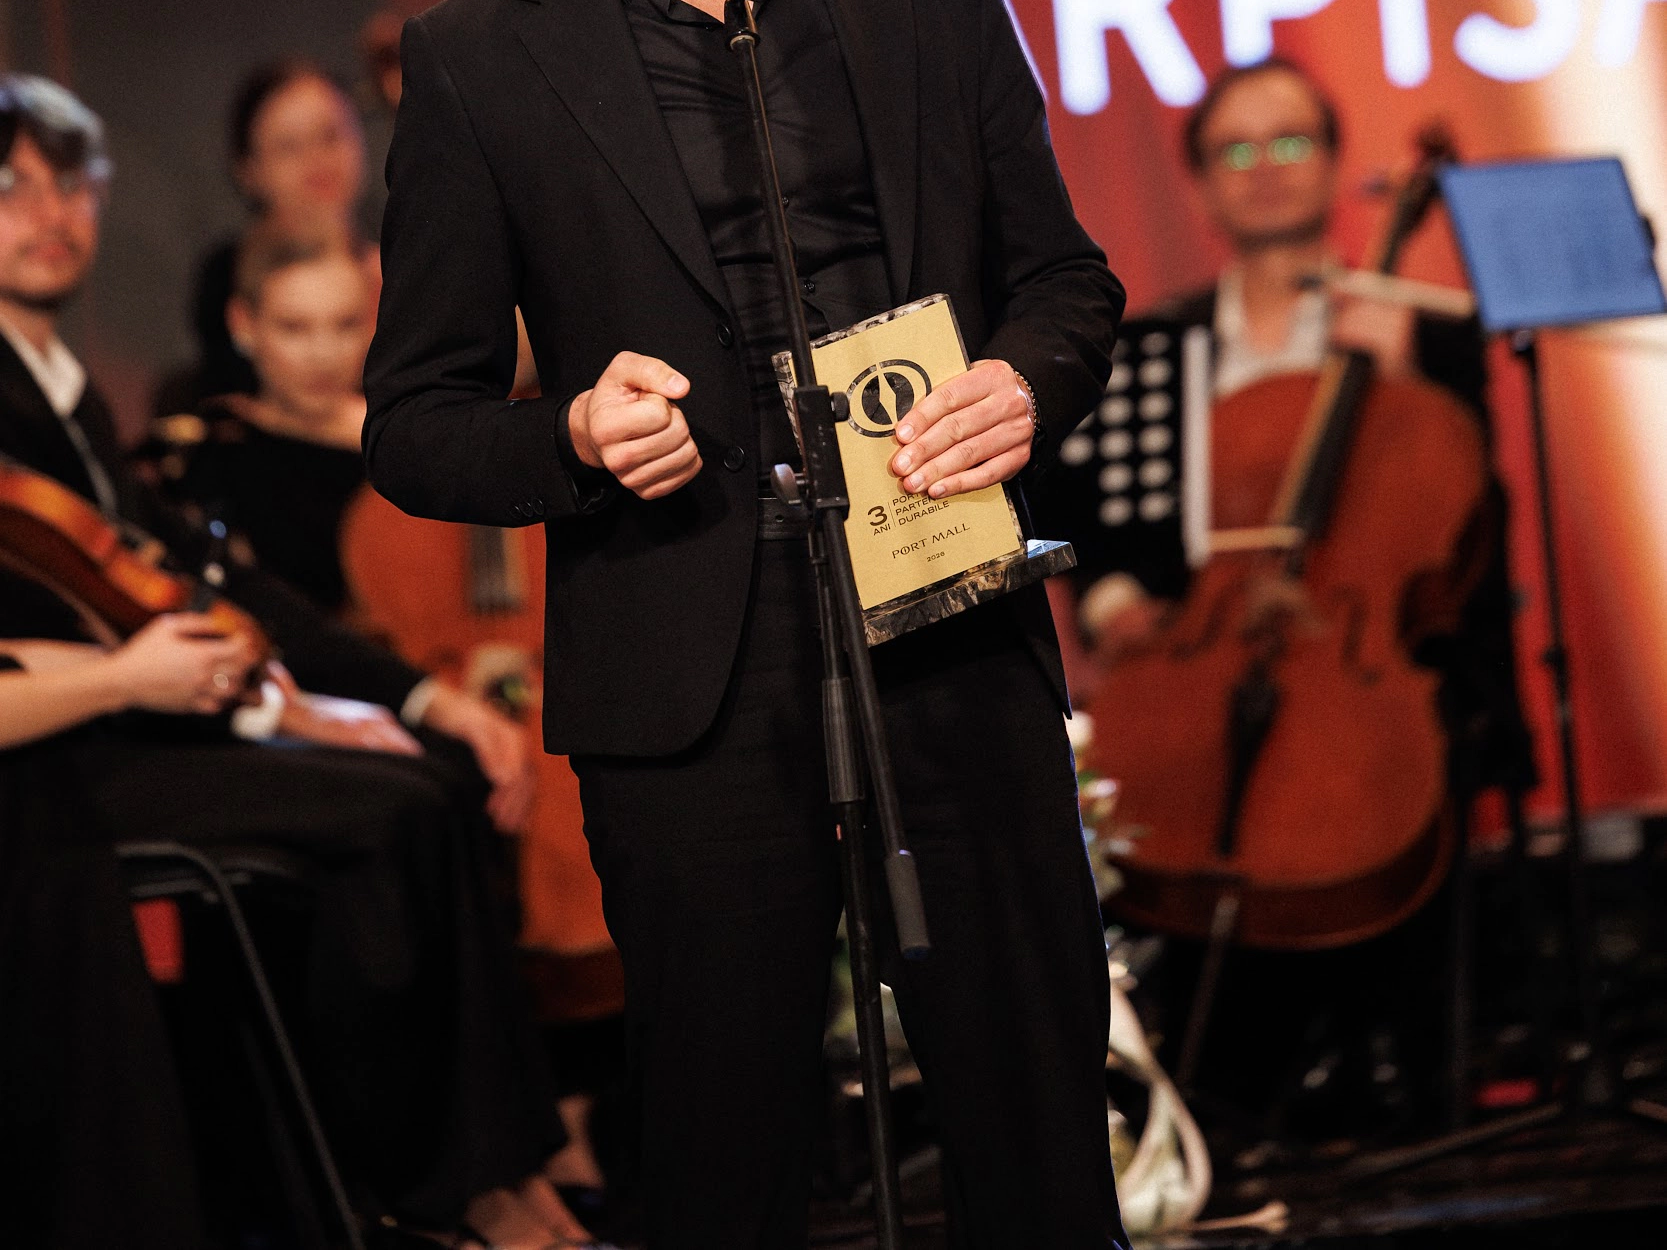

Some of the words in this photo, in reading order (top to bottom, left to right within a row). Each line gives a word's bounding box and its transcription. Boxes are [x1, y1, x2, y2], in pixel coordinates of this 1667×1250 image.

[867, 505, 888, 527] 3
[898, 500, 950, 526] DURABILE
[873, 523, 891, 536] ANI
[892, 538, 927, 559] PORT
[932, 523, 970, 543] MALL
